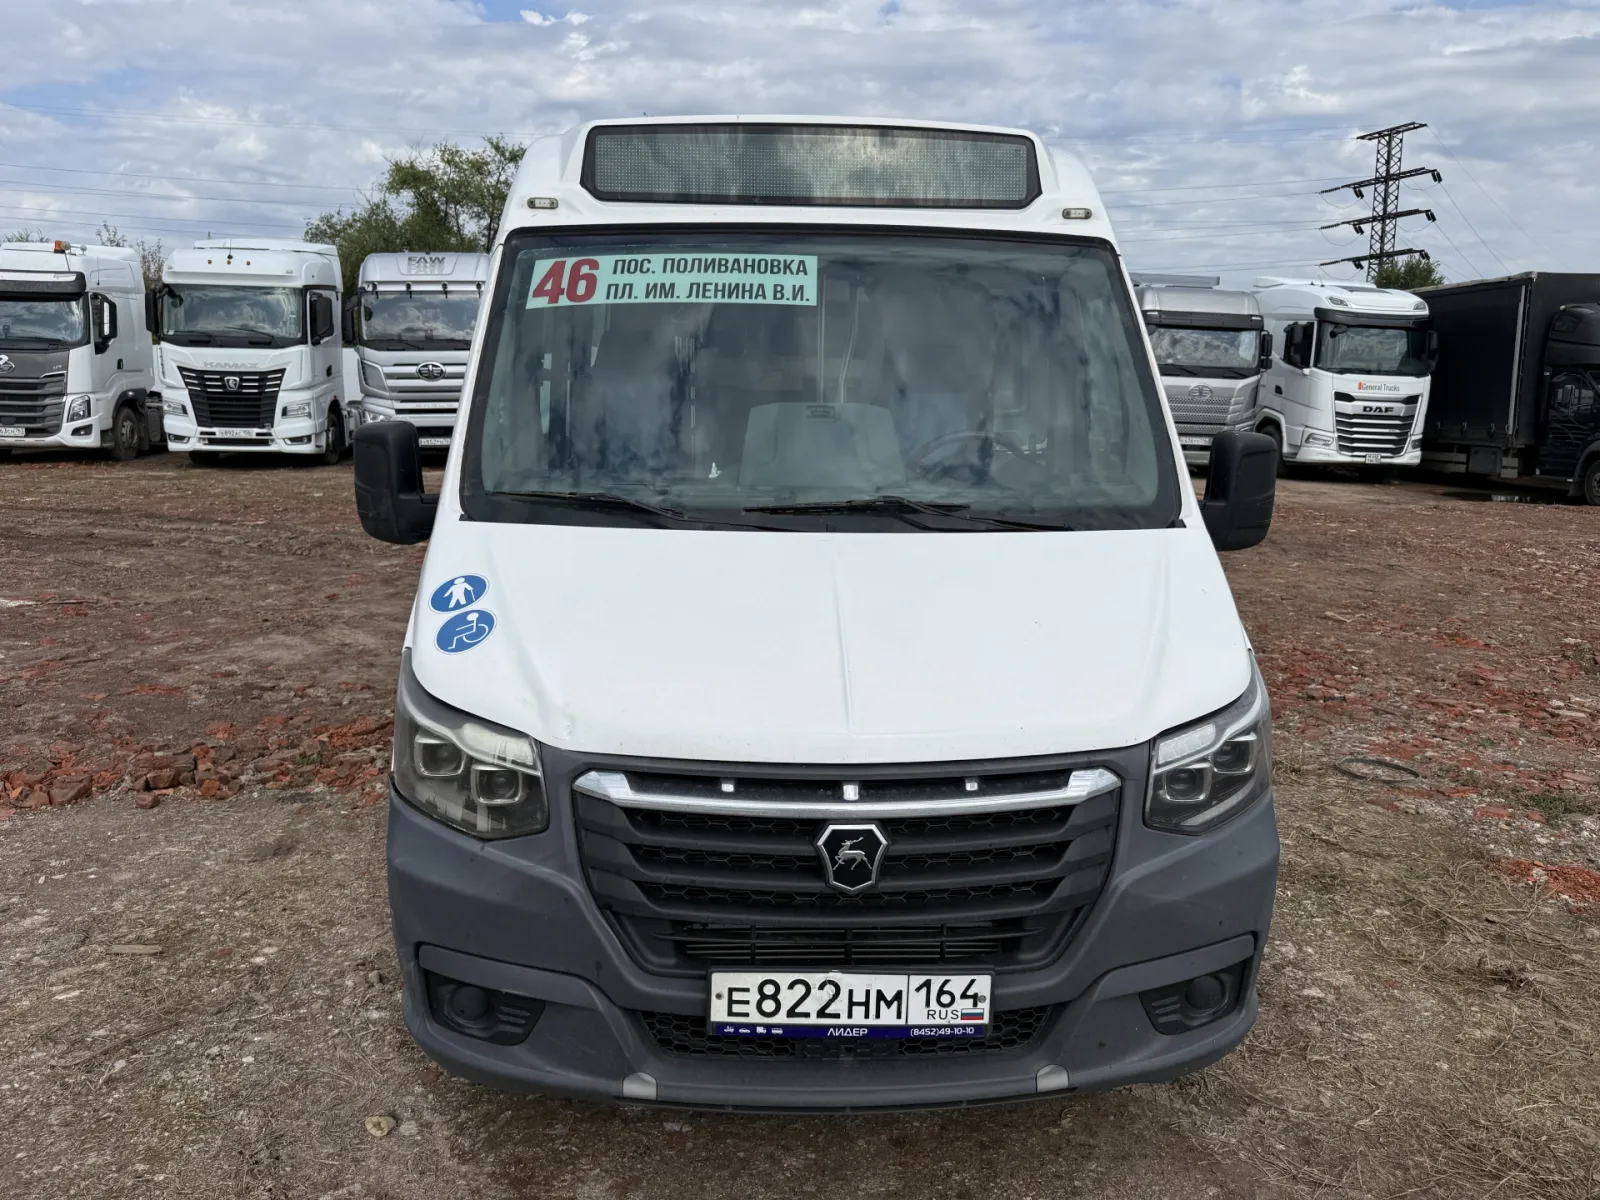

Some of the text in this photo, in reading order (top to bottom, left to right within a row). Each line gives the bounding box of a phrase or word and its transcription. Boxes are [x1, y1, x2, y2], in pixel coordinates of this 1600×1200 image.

[612, 257, 808, 276] ПОС. ПОЛИВАНОВКА
[532, 258, 600, 304] 46
[605, 282, 810, 302] ПЛ. ИМ. ЛЕНИНА В.И.
[1383, 383, 1400, 392] Trucks
[727, 978, 980, 1020] Е822НМ 164
[927, 1009, 959, 1020] RUS
[827, 1026, 975, 1037] ЛИДЕР (8452)49-10-10
